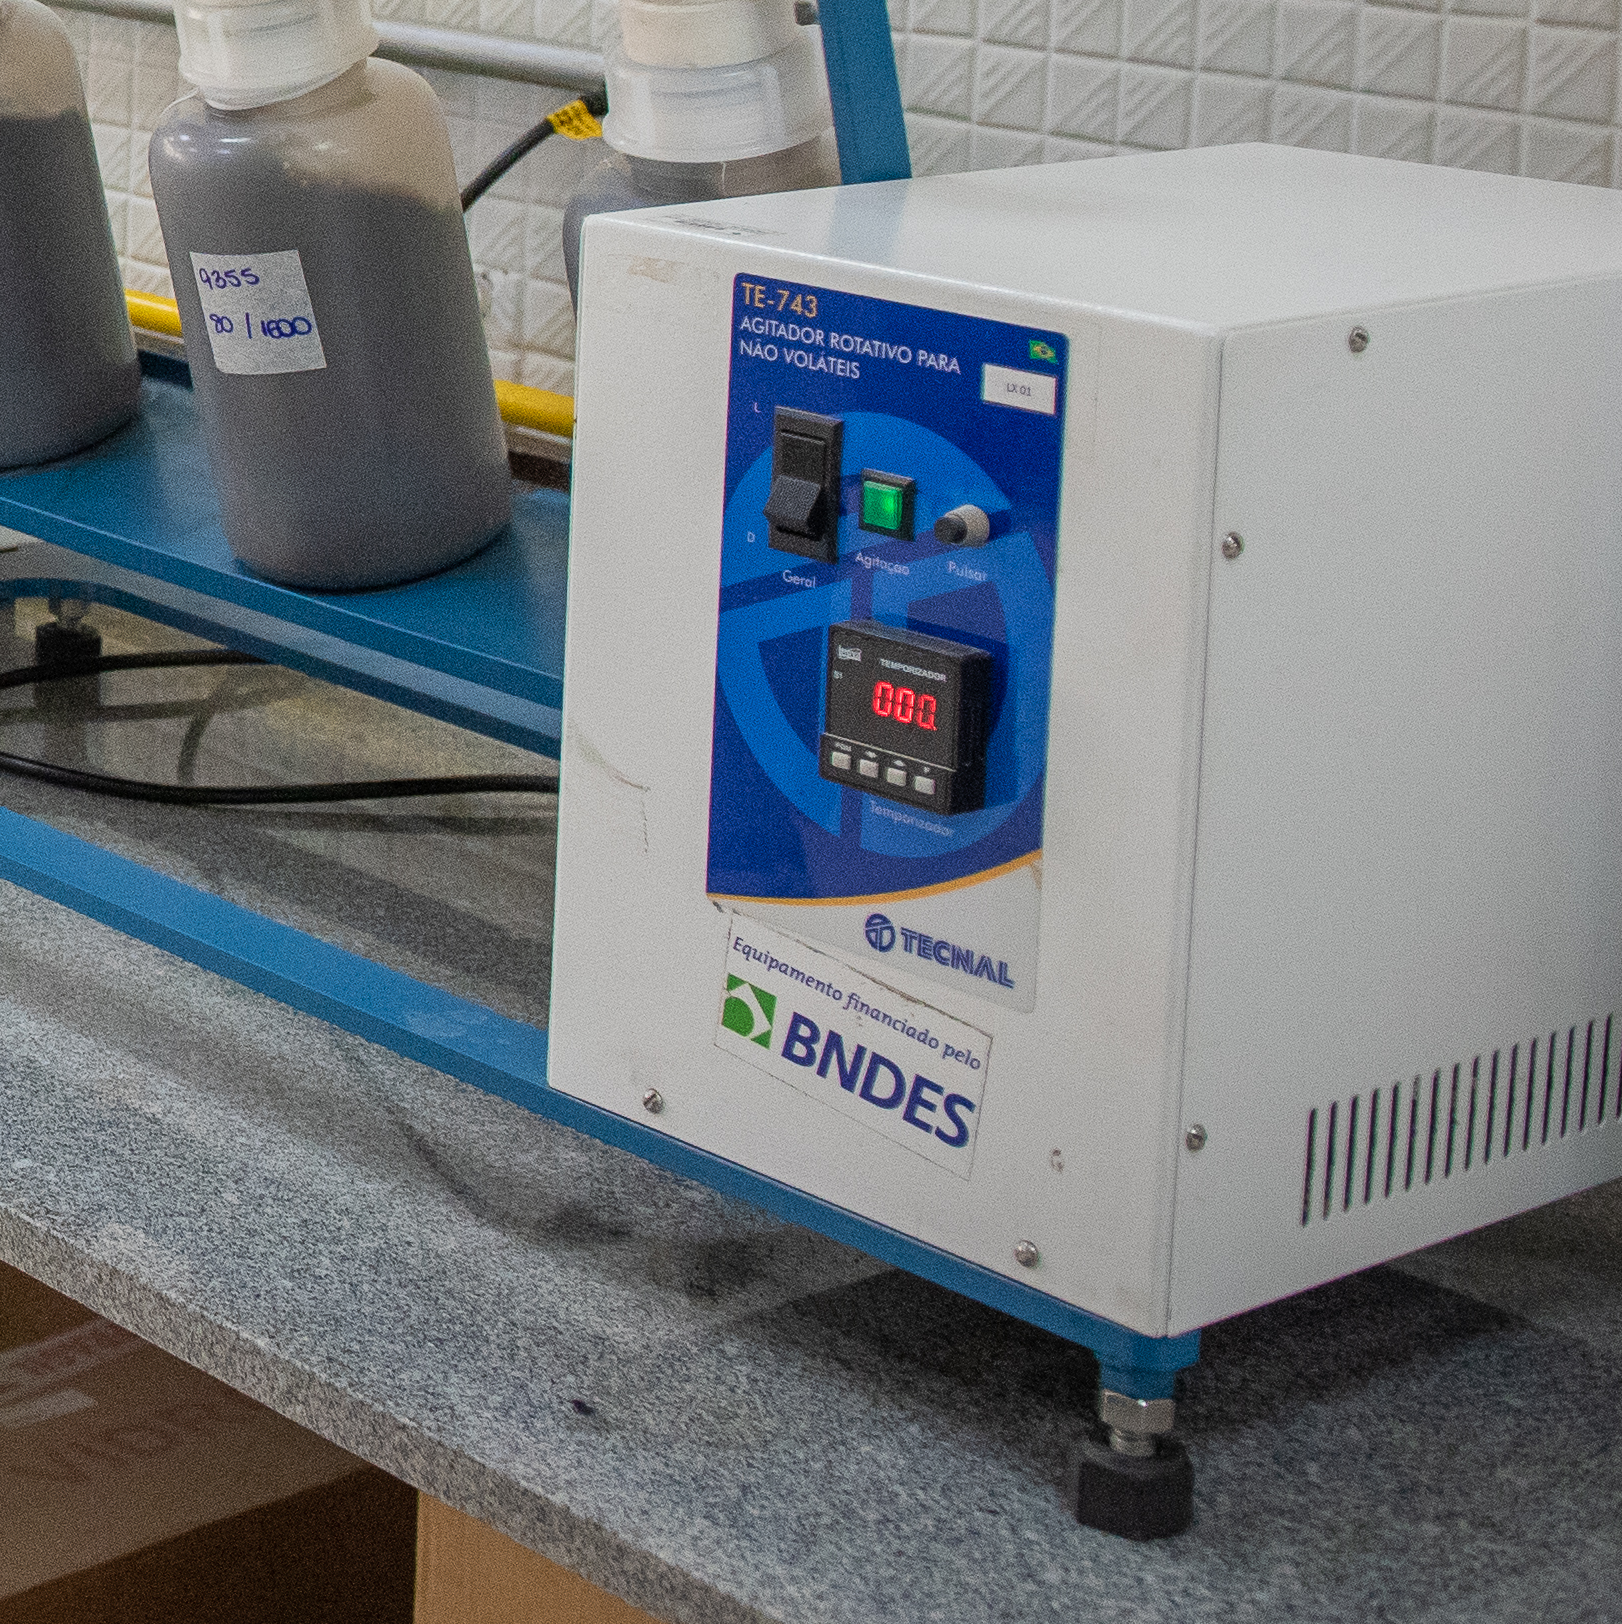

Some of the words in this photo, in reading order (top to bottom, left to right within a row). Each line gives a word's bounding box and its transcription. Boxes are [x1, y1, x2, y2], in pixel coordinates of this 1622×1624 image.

[199, 267, 260, 290] 9355
[741, 282, 818, 317] TE-743
[209, 313, 234, 334] 80
[740, 317, 825, 347] AGITADOR
[830, 332, 912, 364] ROTATIVO
[917, 349, 961, 375] PARA
[740, 338, 778, 362] NÃO
[783, 347, 860, 379] VOLÁTEIS
[1020, 384, 1032, 397] 01
[782, 569, 816, 589] Geral
[900, 926, 1015, 989] TECNAL
[732, 936, 842, 1001] Equipamento
[843, 992, 939, 1050] financiado
[941, 1042, 982, 1070] pelo
[781, 1011, 977, 1149] BNDES
